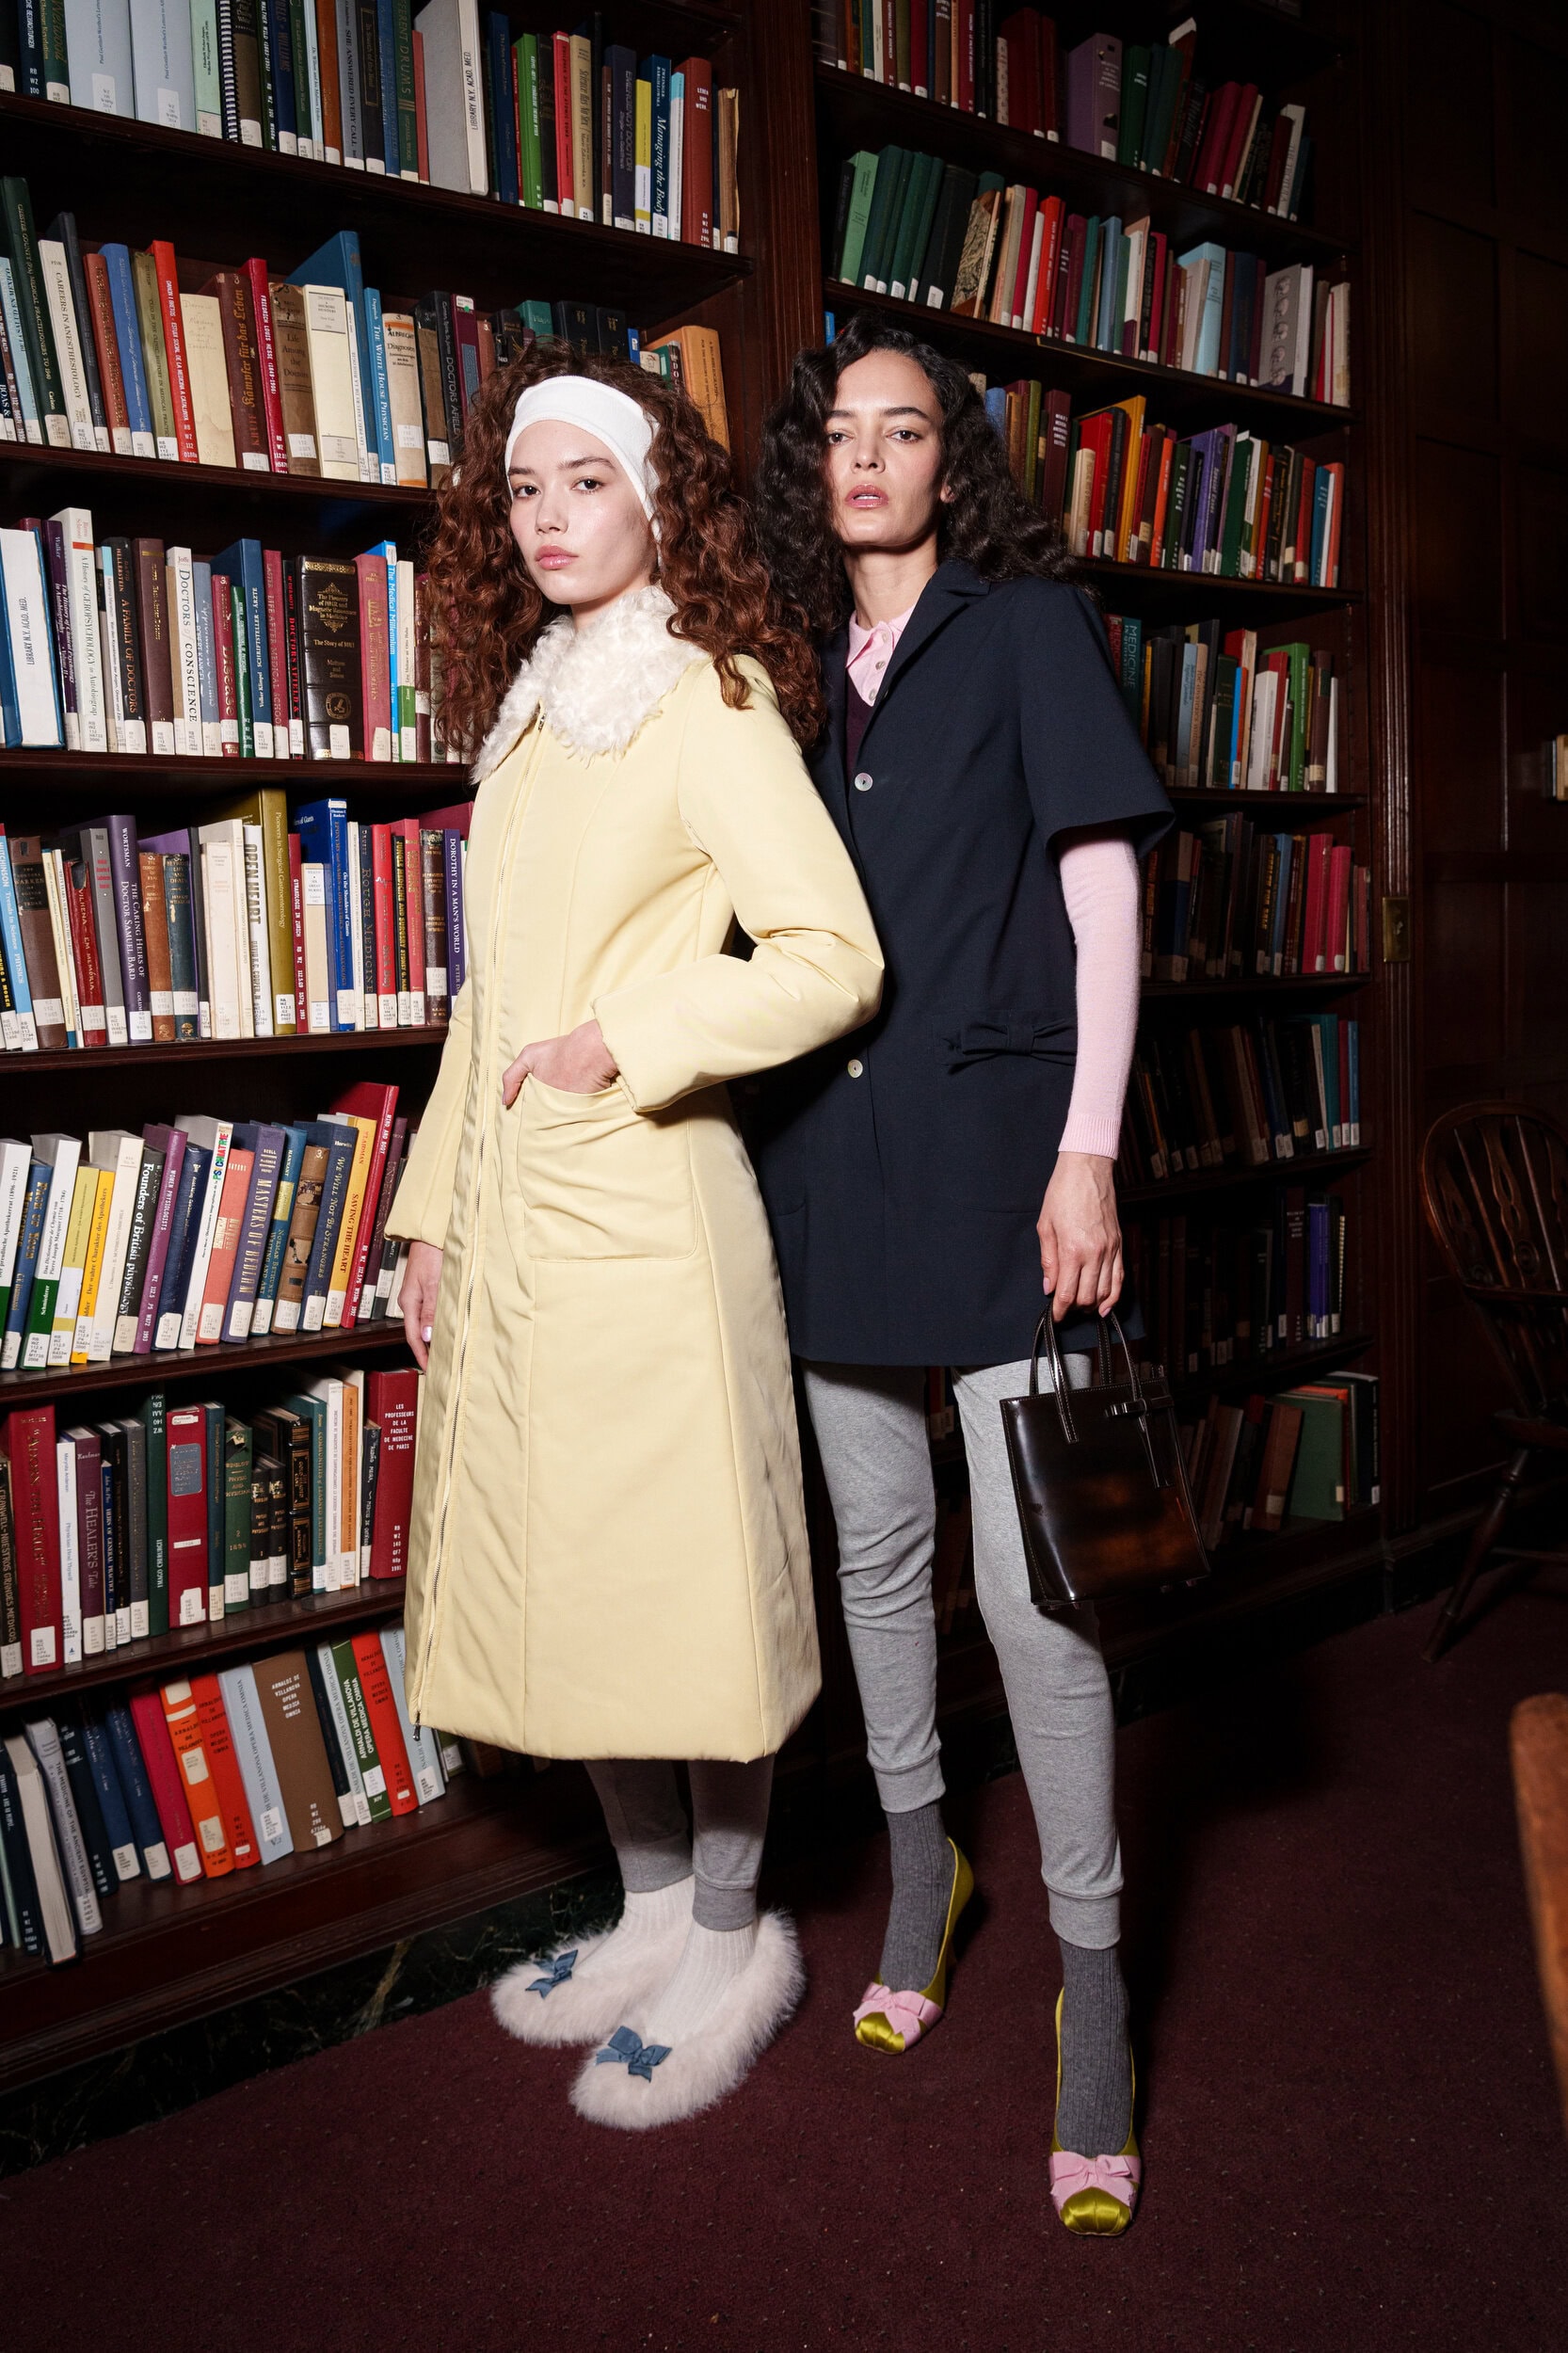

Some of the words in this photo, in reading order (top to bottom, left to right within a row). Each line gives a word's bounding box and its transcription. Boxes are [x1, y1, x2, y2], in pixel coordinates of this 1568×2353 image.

[345, 49, 355, 94] ANSWERED
[465, 69, 473, 88] ACAD.
[624, 70, 632, 129] EMERGENCY
[468, 103, 478, 130] LIBRARY
[625, 130, 633, 172] DOCTOR
[653, 115, 665, 168] Managing
[656, 169, 665, 185] the
[654, 187, 664, 213] Body
[55, 272, 67, 312] CAREERS
[62, 312, 69, 323] IN
[373, 325, 381, 343] THE
[63, 322, 81, 400] ANESTHESIOLOGY
[375, 344, 383, 369] WHITE
[0, 383, 9, 408] BOAS
[377, 371, 386, 399] HOUSE
[3, 408, 11, 418] &
[379, 400, 390, 441] PHYSICIAN
[18, 596, 27, 612] MED.
[120, 599, 130, 607] A
[179, 568, 193, 627] DOCTORS
[21, 612, 29, 630] ACAD.
[121, 608, 133, 646] FAMILY
[268, 616, 277, 645] AFTER
[23, 630, 31, 641] N.Y.
[324, 640, 337, 648] Story
[24, 641, 34, 664] LIBRARY
[124, 647, 134, 663] OF
[288, 616, 297, 664] DOCTORS
[293, 705, 299, 713] &
[1127, 625, 1137, 691] MEDICINE
[222, 645, 235, 716] Disease
[270, 647, 279, 689] MEDICAL
[125, 664, 138, 712] DOCTORS
[184, 643, 197, 722] CONSCIENCE
[121, 827, 131, 868] WORTSMAN
[243, 842, 259, 879] OPEN
[394, 840, 404, 867] JUNGLE
[449, 838, 457, 877] DOROTHY
[361, 868, 372, 918] ROUGH
[396, 868, 405, 902] MEDICINE
[451, 879, 457, 888] IN
[120, 880, 131, 917] DOCTOR
[246, 881, 262, 924] HEART
[277, 874, 286, 928] Gastroenterology
[132, 902, 142, 936] CARING
[398, 917, 407, 948] SURGERY
[83, 936, 90, 950] EM
[123, 920, 135, 954] SAMUEL
[136, 937, 144, 964] HEIRS
[452, 923, 460, 953] WORLD
[127, 955, 136, 980] BARD
[364, 922, 375, 993] MEDICINE
[137, 966, 145, 977] OF
[335, 1156, 345, 1172] WE
[136, 1162, 153, 1210] Founders
[168, 1169, 176, 1188] WOMEN
[330, 1172, 343, 1196] WILL
[32, 1180, 48, 1210] PACK
[96, 1187, 109, 1221] Apothekers
[248, 1177, 272, 1229] MASTERS
[327, 1196, 338, 1216] NOT
[347, 1193, 359, 1224] SAVING
[30, 1212, 41, 1227] UP
[135, 1210, 146, 1225] of
[325, 1216, 335, 1230] BE
[90, 1232, 101, 1263] Charakter
[128, 1225, 145, 1260] British
[246, 1230, 262, 1246] OF
[264, 1231, 277, 1262] WRITING
[273, 1228, 284, 1259] NORMAN
[344, 1225, 353, 1243] THE
[315, 1229, 332, 1279] STRANGERS
[339, 1243, 350, 1273] HEART
[88, 1263, 96, 1282] wahre
[237, 1249, 259, 1294] BEDLAM
[261, 1263, 269, 1279] AND
[85, 1282, 93, 1294] Der
[118, 1261, 139, 1316] physiology
[258, 1280, 267, 1294] ART
[84, 1490, 95, 1505] The
[84, 1506, 101, 1568] HEALER'S
[4, 1572, 13, 1606] GRANDES
[88, 1570, 99, 1589] Tale
[322, 1650, 333, 1675] OMNIA
[236, 1678, 247, 1704] OMNIA
[275, 1683, 301, 1697] VILLANOVA
[328, 1676, 339, 1701] MEDICA
[342, 1678, 358, 1718] VILLANOVA
[350, 1676, 361, 1701] OMNIA
[242, 1704, 253, 1731] MEDICA
[334, 1702, 344, 1723] OPERA
[351, 1717, 360, 1728] DE
[356, 1701, 368, 1728] MEDICA
[248, 1731, 258, 1754] OPERA
[353, 1727, 367, 1759] ARNALDI
[361, 1727, 375, 1753] OPERA
[55, 1761, 63, 1775] THE
[253, 1753, 267, 1793] VILLANOVA
[58, 1776, 71, 1807] MEDICINE
[262, 1793, 269, 1802] DE
[66, 1809, 72, 1818] OF
[72, 1834, 83, 1864] ANCIENT
